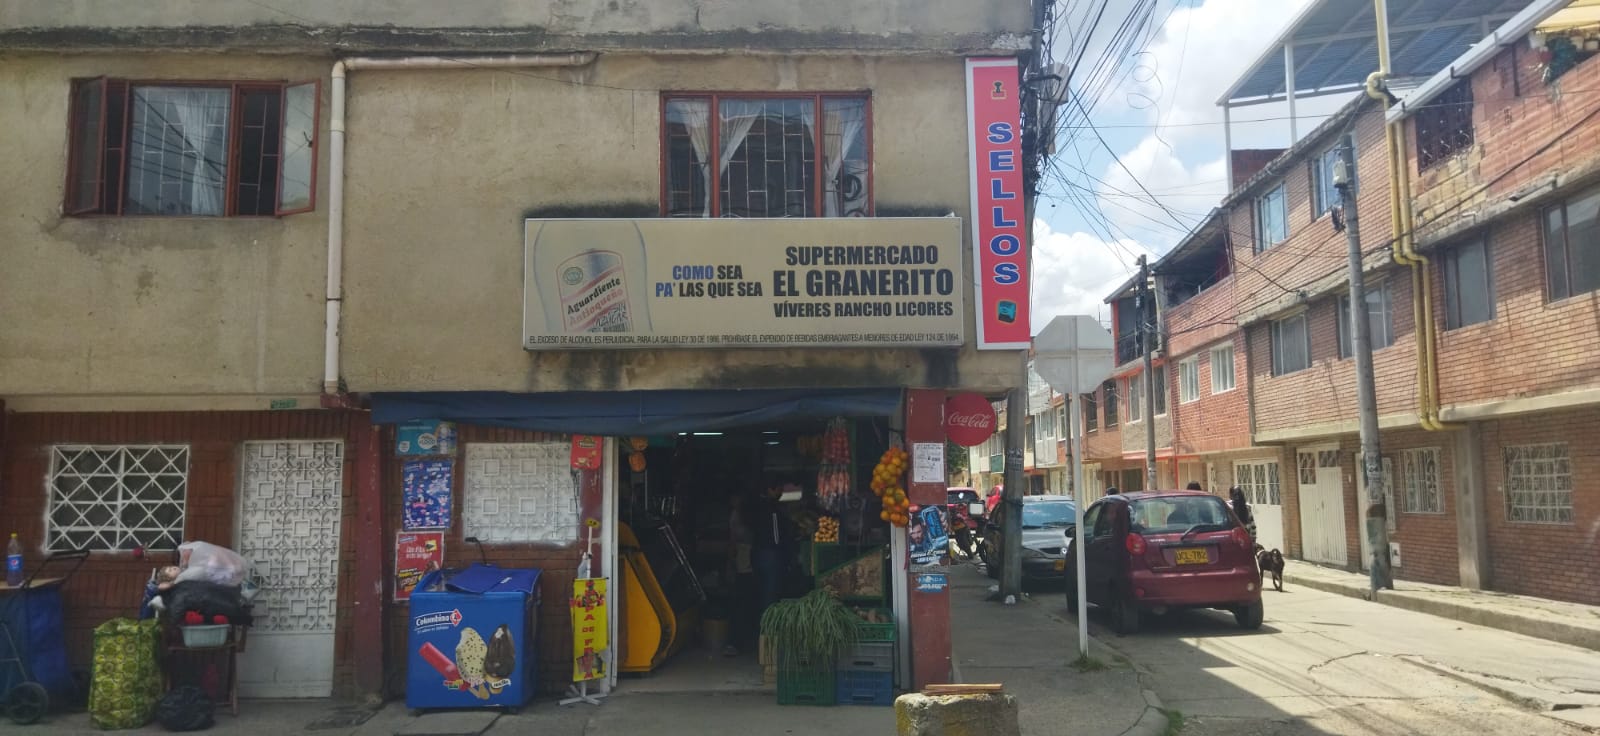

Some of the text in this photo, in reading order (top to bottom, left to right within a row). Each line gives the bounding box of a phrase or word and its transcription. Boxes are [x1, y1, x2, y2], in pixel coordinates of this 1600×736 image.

[987, 122, 1020, 284] SELLOS
[786, 245, 938, 265] SUPERMERCADO
[672, 265, 742, 280] COMO SEA
[655, 282, 762, 298] PA' LAS QUE SEA
[773, 269, 954, 297] EL GRANERITO
[567, 278, 620, 315] Aguardiente
[774, 301, 953, 318] VÍVERES RANCHO LICORES
[529, 336, 536, 344] EL
[537, 336, 559, 344] EXCESO
[560, 336, 567, 344] DE
[594, 336, 602, 344] ES
[602, 336, 635, 344] PERJUDICIAL
[678, 335, 688, 343] LEY
[697, 335, 705, 343] DE
[752, 335, 758, 343] EL
[759, 335, 786, 343] EXPENDIO
[794, 334, 817, 342] BEBIDAS
[890, 334, 898, 342] DE
[936, 333, 944, 341] DE
[948, 411, 991, 429] Coca-Cola
[416, 614, 449, 626] Colombina
